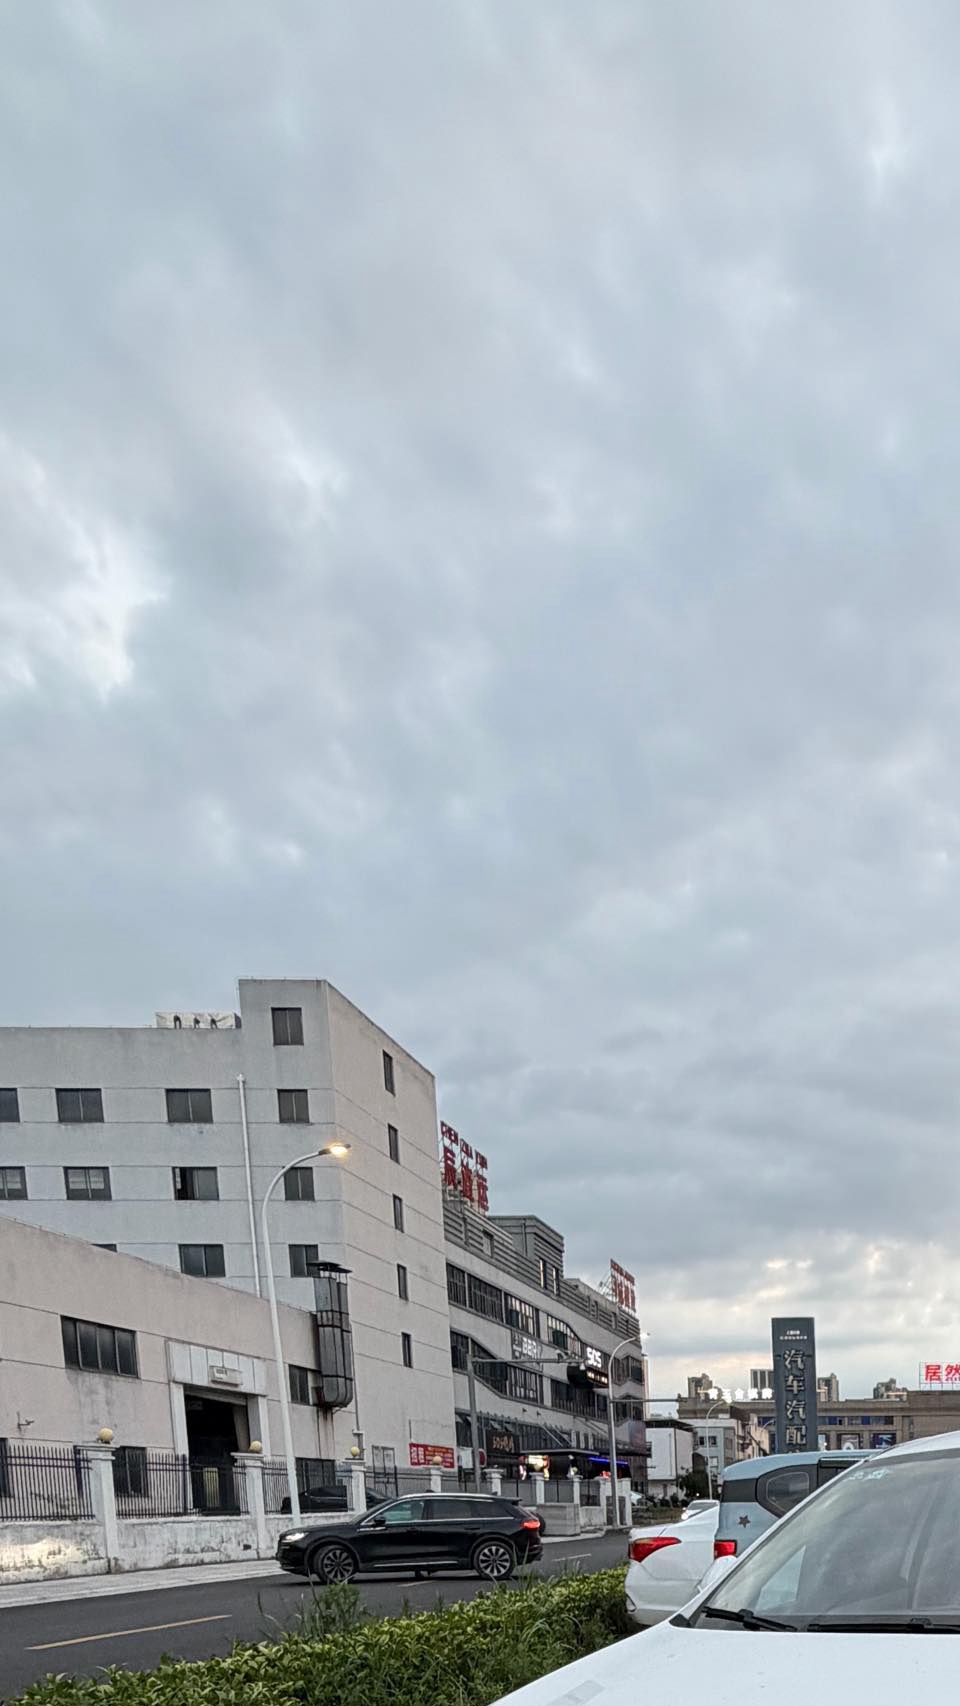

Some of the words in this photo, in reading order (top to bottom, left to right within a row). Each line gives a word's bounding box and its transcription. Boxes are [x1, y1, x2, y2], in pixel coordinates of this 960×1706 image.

[783, 1349, 807, 1453] 汽车汽配
[924, 1363, 960, 1382] 居然
